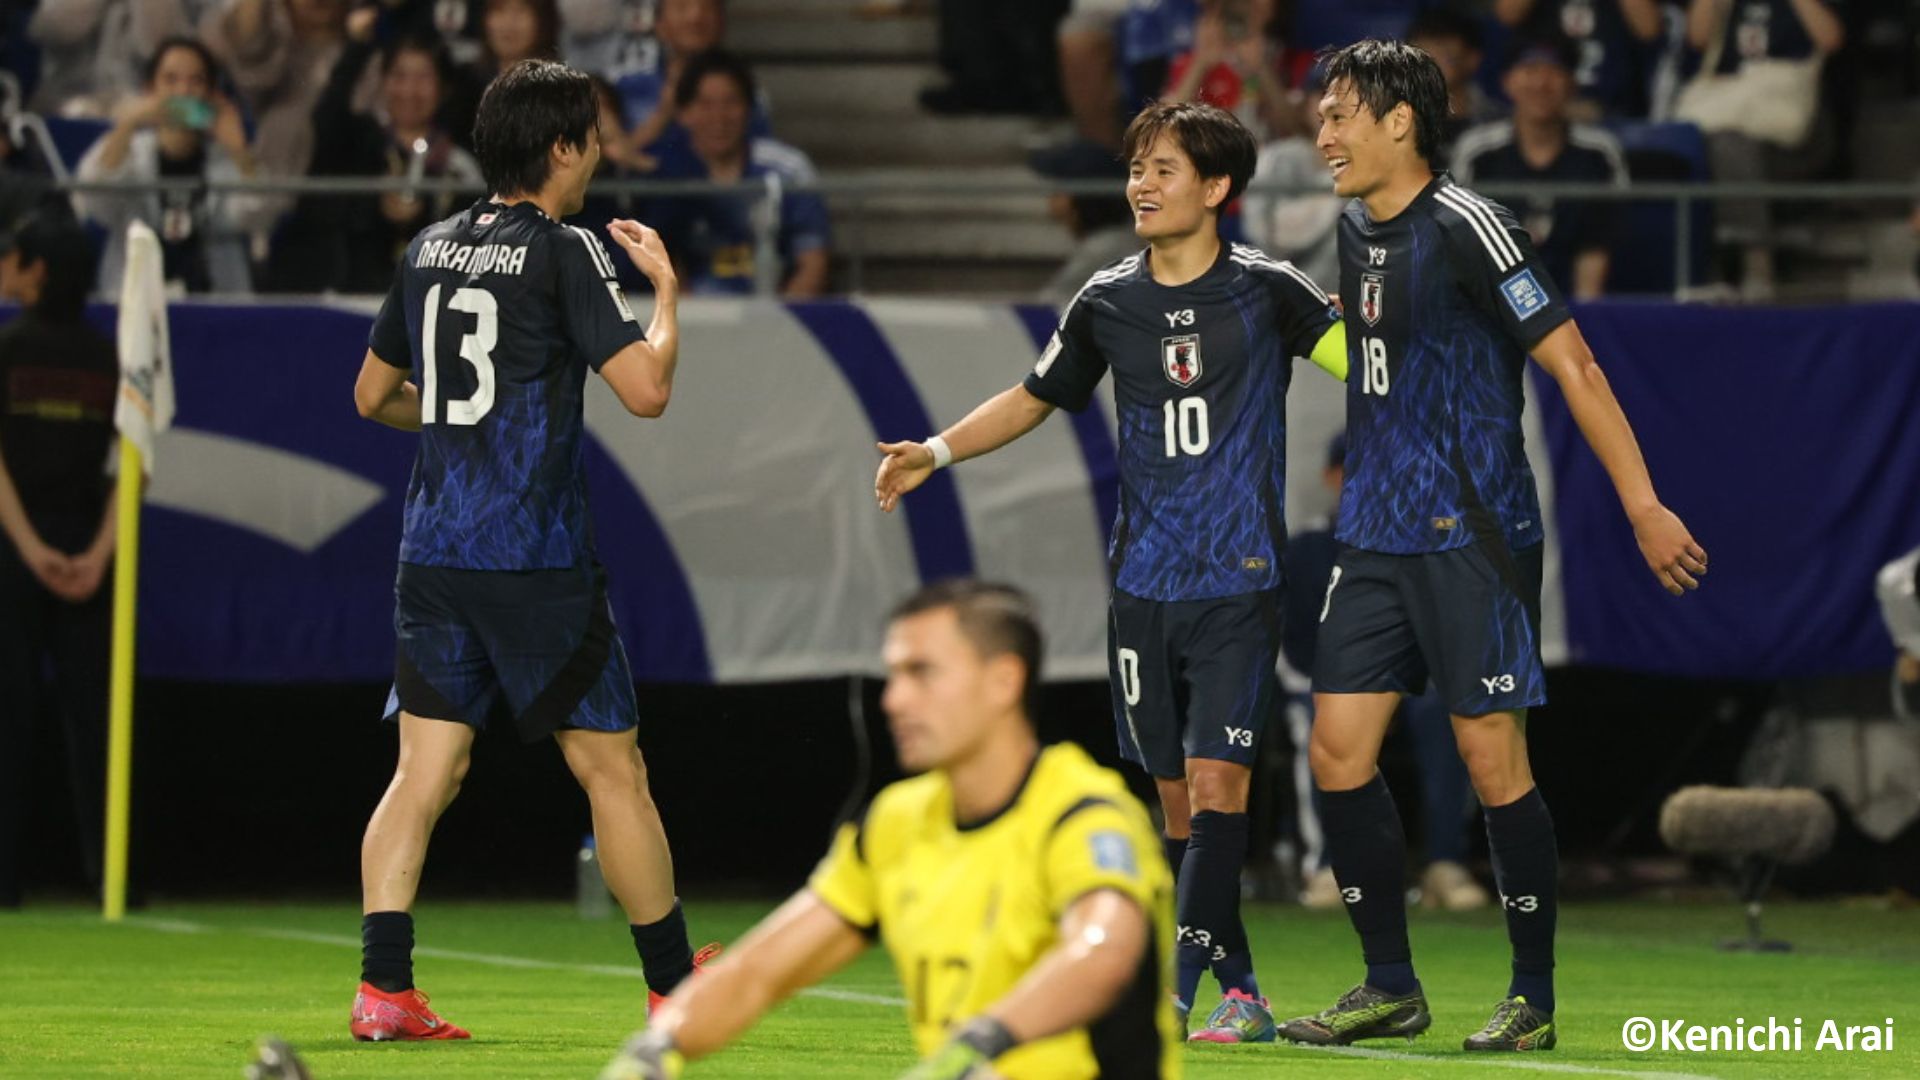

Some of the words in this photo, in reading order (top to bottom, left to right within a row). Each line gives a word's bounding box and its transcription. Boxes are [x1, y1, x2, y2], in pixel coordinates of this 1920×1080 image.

[416, 239, 528, 275] NAKAMURA
[1164, 308, 1195, 329] Y-3
[422, 283, 499, 425] 13
[1362, 336, 1390, 395] 18
[1163, 396, 1210, 458] 10
[1480, 674, 1515, 695] Y-3
[1224, 725, 1253, 747] Y-3
